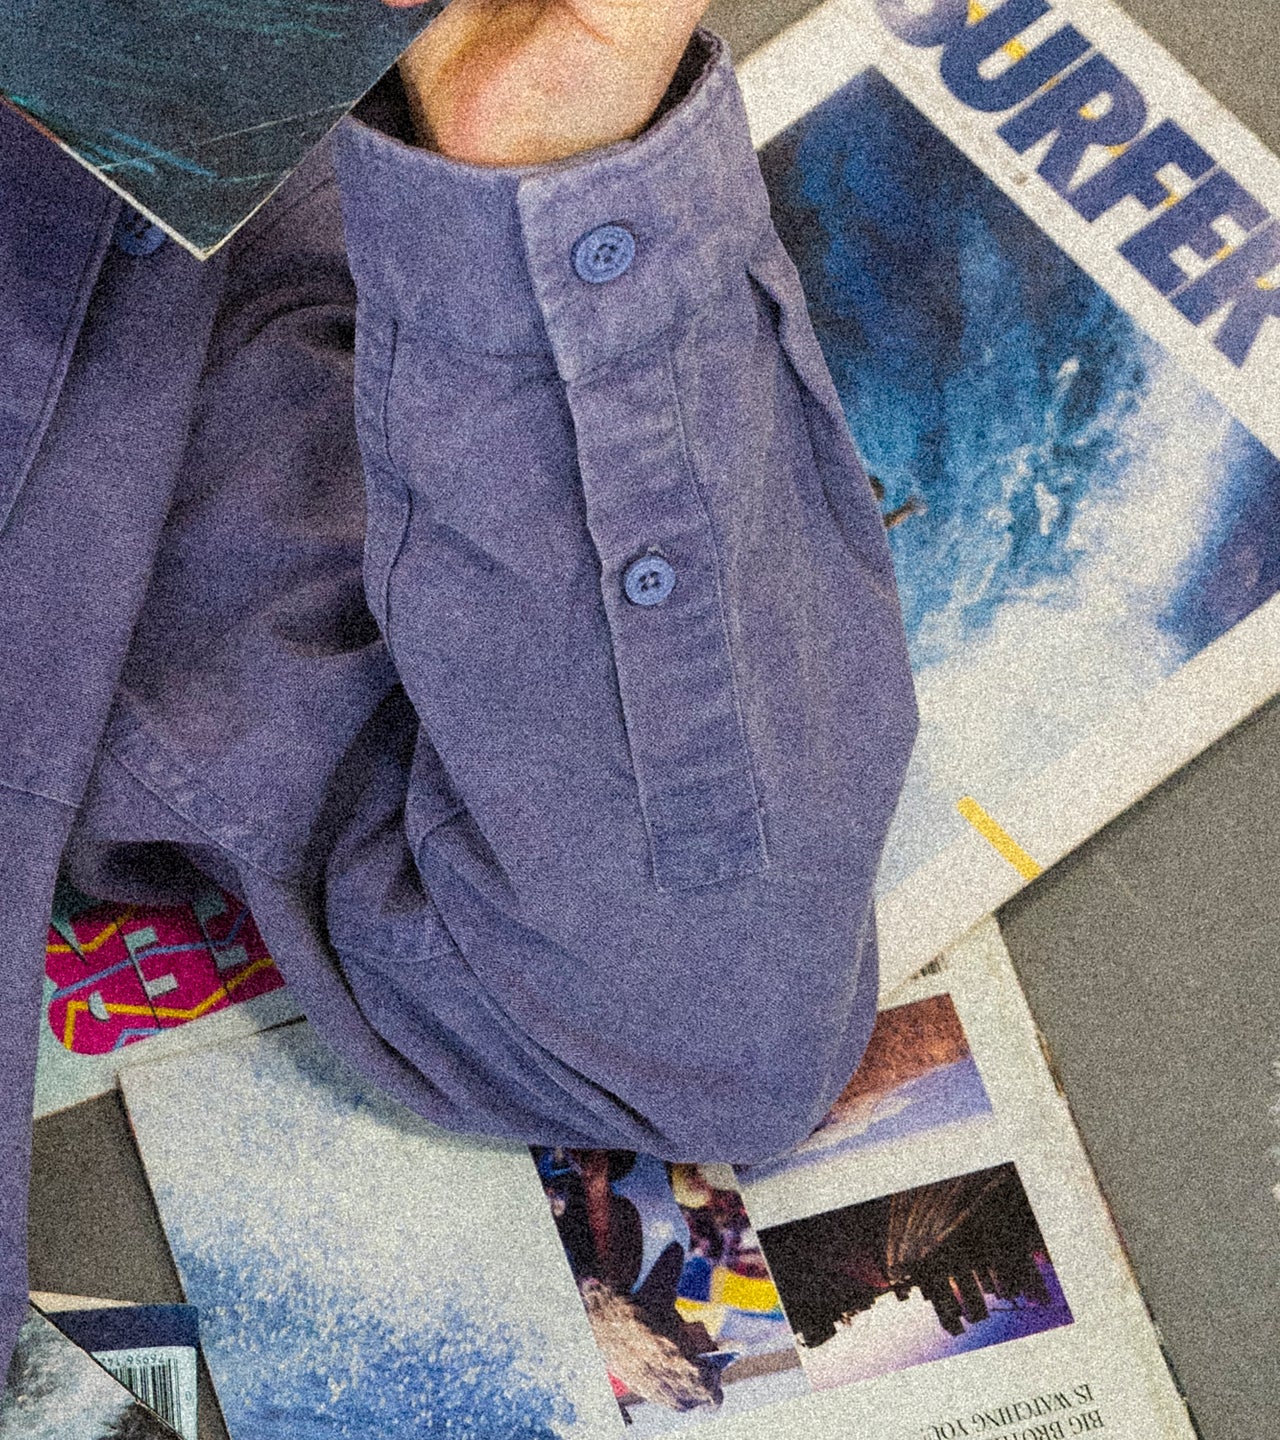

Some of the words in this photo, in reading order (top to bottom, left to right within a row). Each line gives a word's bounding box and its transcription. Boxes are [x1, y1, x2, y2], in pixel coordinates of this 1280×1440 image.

[1071, 1383, 1093, 1408] IS
[969, 1389, 1070, 1432] WATCHING
[1067, 1408, 1103, 1436] BIG
